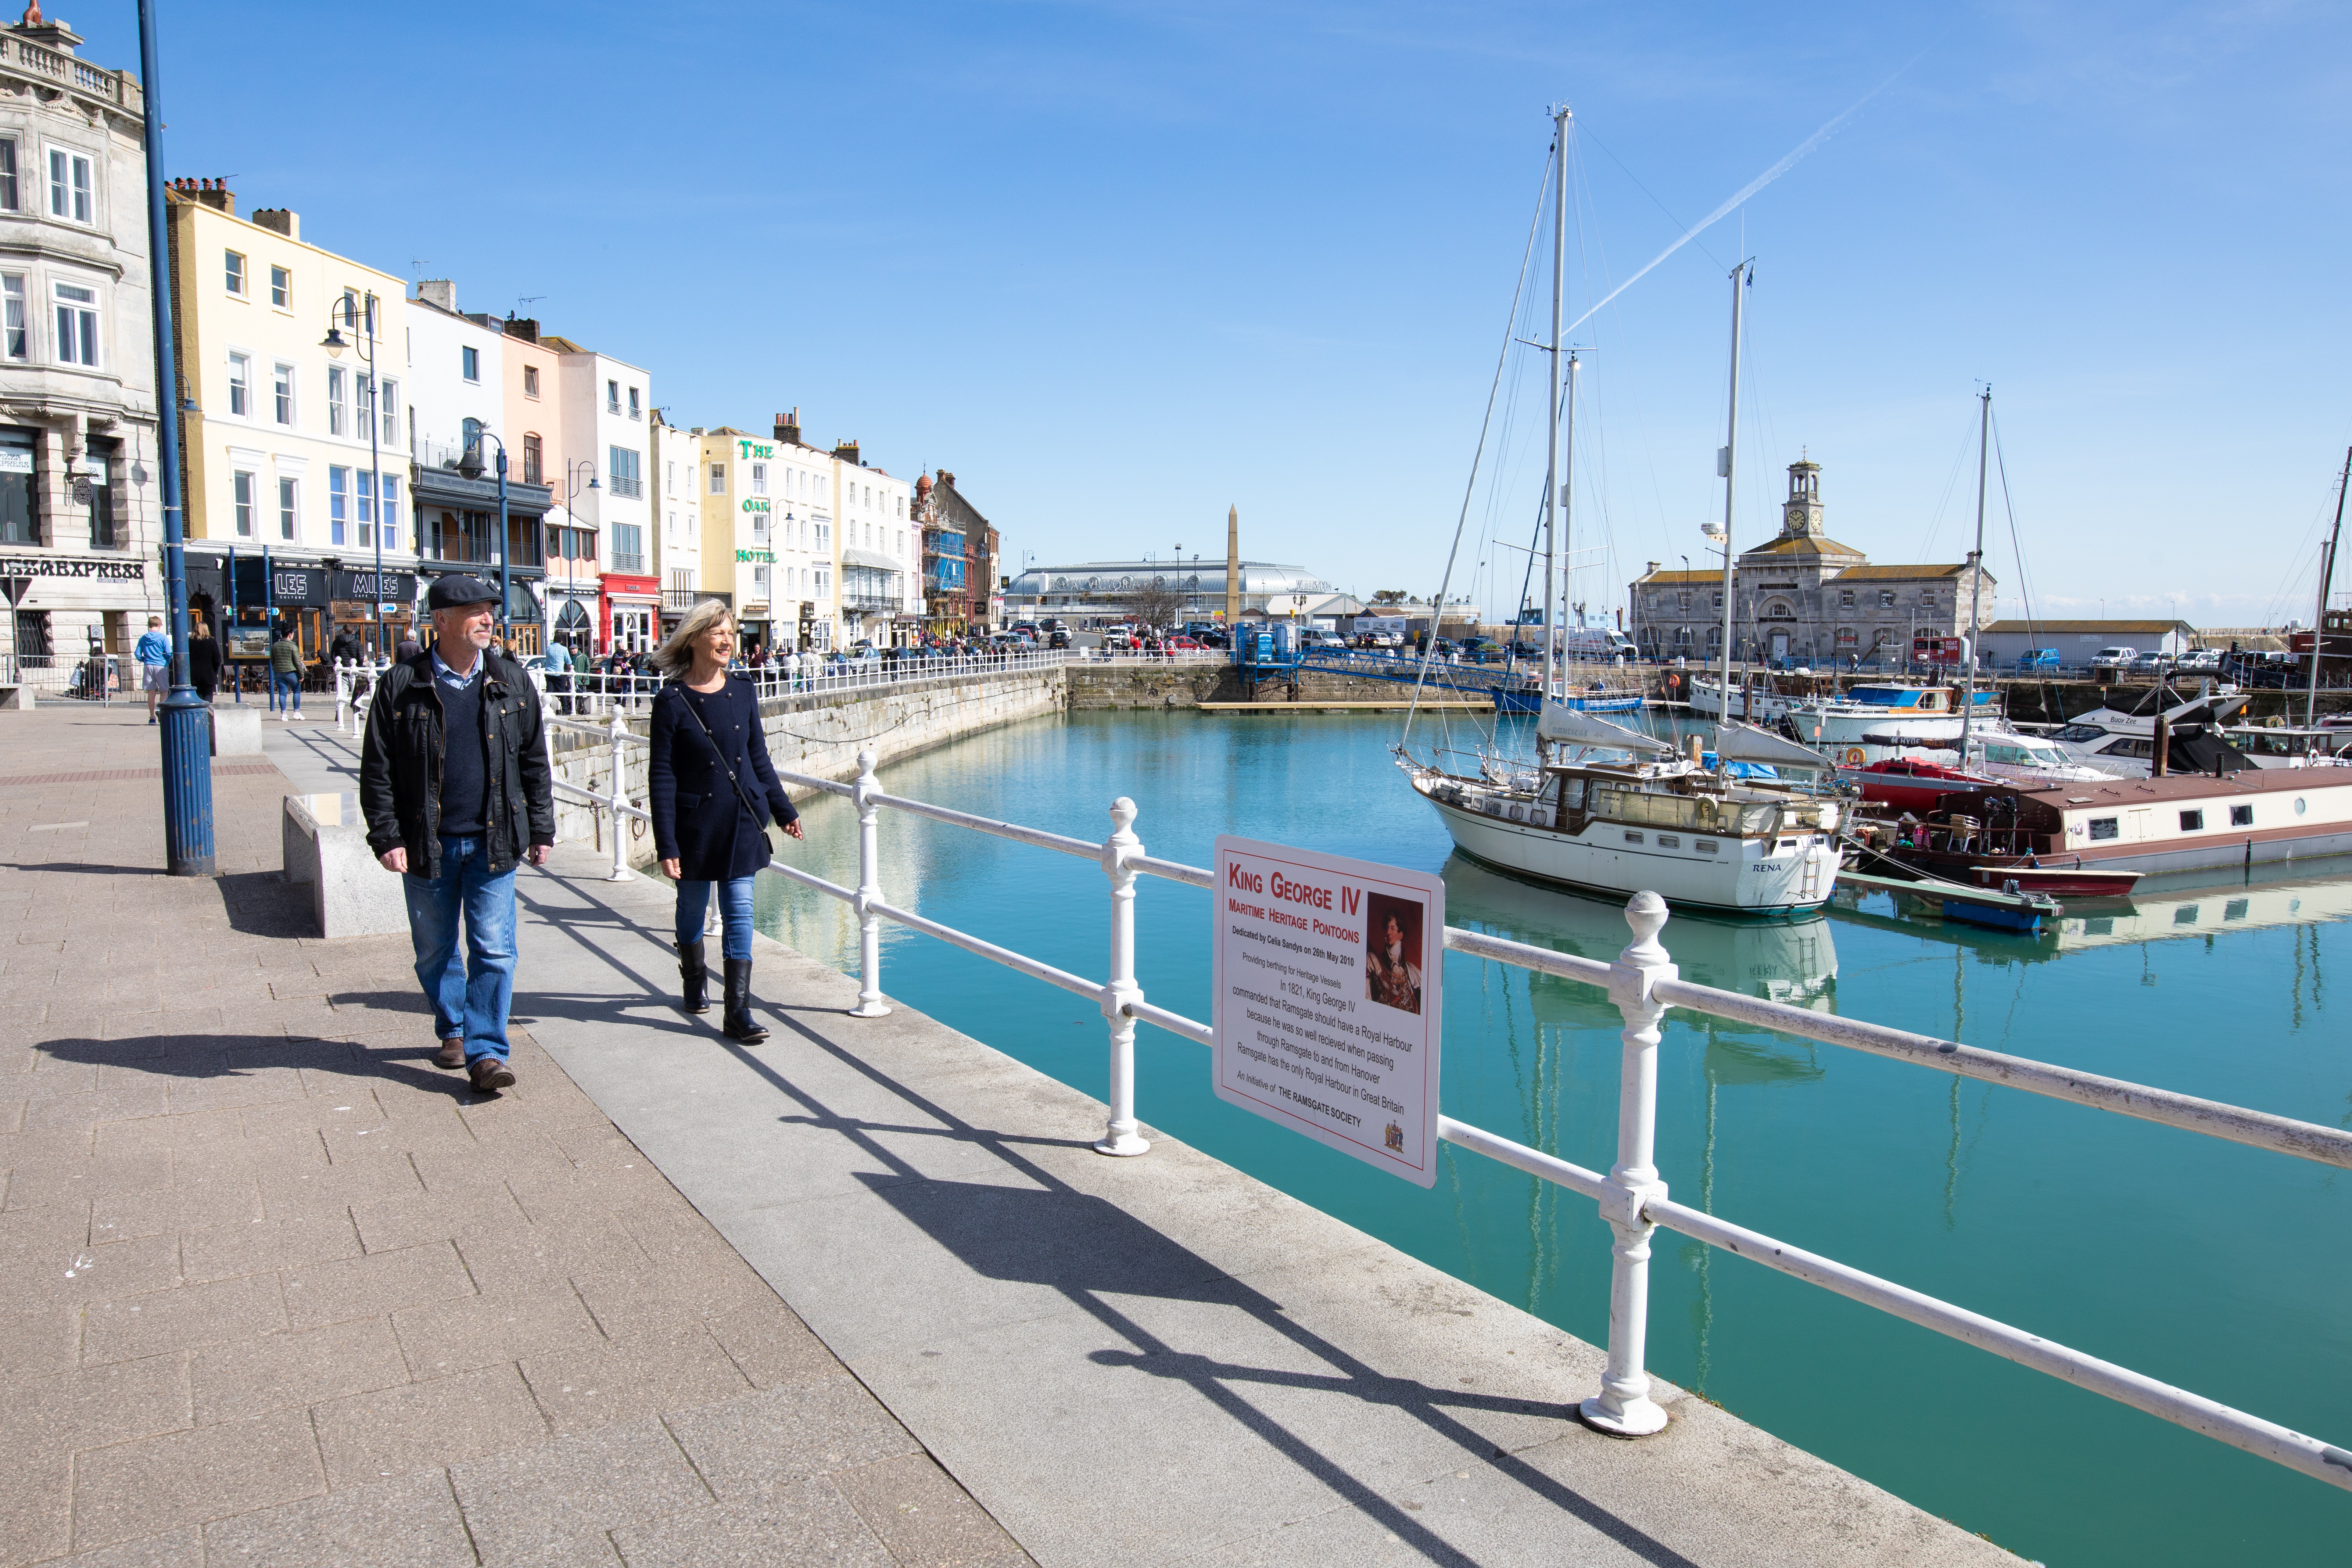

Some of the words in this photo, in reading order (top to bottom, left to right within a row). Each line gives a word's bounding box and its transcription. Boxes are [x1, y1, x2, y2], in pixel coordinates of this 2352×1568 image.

[739, 439, 774, 458] THE
[743, 499, 770, 511] OAK
[736, 549, 778, 562] HOTEL
[275, 574, 307, 595] LES
[2234, 669, 2249, 677] CERIA
[1753, 864, 1782, 872] RENA
[1229, 861, 1262, 894] KING
[1270, 871, 1332, 911] GEORGE
[1341, 885, 1361, 916] IV
[1229, 897, 1265, 920] MARITIME
[1269, 907, 1308, 931] HERITAGE
[1313, 918, 1359, 944] PONTOONS
[1232, 925, 1258, 940] Dedicated
[1259, 932, 1266, 944] by
[1267, 934, 1281, 947] Celia
[1281, 938, 1302, 953] Sandys
[1304, 946, 1311, 955] on
[1312, 947, 1325, 959] 26th
[1326, 950, 1339, 964] May
[1340, 954, 1354, 967] 2010
[1242, 951, 1265, 969] Providing
[1266, 958, 1287, 975] berthing
[1296, 967, 1319, 983] Heritage
[1320, 974, 1341, 989] Vessels
[1280, 979, 1286, 991] In
[1288, 982, 1304, 999] 1821,
[1306, 987, 1320, 1005] King
[1322, 992, 1346, 1012] George
[1348, 1000, 1356, 1013] IV
[1232, 986, 1268, 1005] commanded
[1269, 995, 1281, 1009] that
[1282, 999, 1313, 1020] Ramsgate
[1314, 1011, 1336, 1027] should
[1337, 1017, 1354, 1033] have
[1355, 1026, 1359, 1036] a
[1361, 1025, 1381, 1043] Royal
[1383, 1032, 1412, 1053] Harbour
[1247, 1007, 1271, 1025] because
[1272, 1015, 1280, 1029] he
[1281, 1021, 1294, 1033] was
[1295, 1026, 1303, 1036] so
[1304, 1029, 1317, 1041] well
[1318, 1034, 1345, 1051] recieved
[1347, 1043, 1365, 1058] when
[1367, 1051, 1394, 1071] passing
[1256, 1030, 1279, 1049] through
[1280, 1038, 1312, 1059] Ramsgate
[1313, 1050, 1319, 1062] to
[1320, 1055, 1333, 1068] and
[1334, 1057, 1349, 1074] from
[1351, 1063, 1380, 1084] Hanover
[1237, 1041, 1266, 1062] Ramsgate
[1268, 1052, 1279, 1067] has
[1280, 1058, 1290, 1071] the
[1291, 1064, 1304, 1079] only
[1305, 1066, 1323, 1084] Royal
[1325, 1074, 1352, 1095] Harbour
[1352, 1084, 1359, 1098] in
[1360, 1088, 1380, 1106] Great
[1381, 1095, 1404, 1115] Britain
[1237, 1070, 1245, 1081] An
[1246, 1073, 1269, 1090] Initiative
[1269, 1084, 1276, 1093] of
[1278, 1086, 1291, 1100] THE
[1292, 1091, 1330, 1115] RAMSGATE
[1330, 1107, 1361, 1128] SOCIETY
